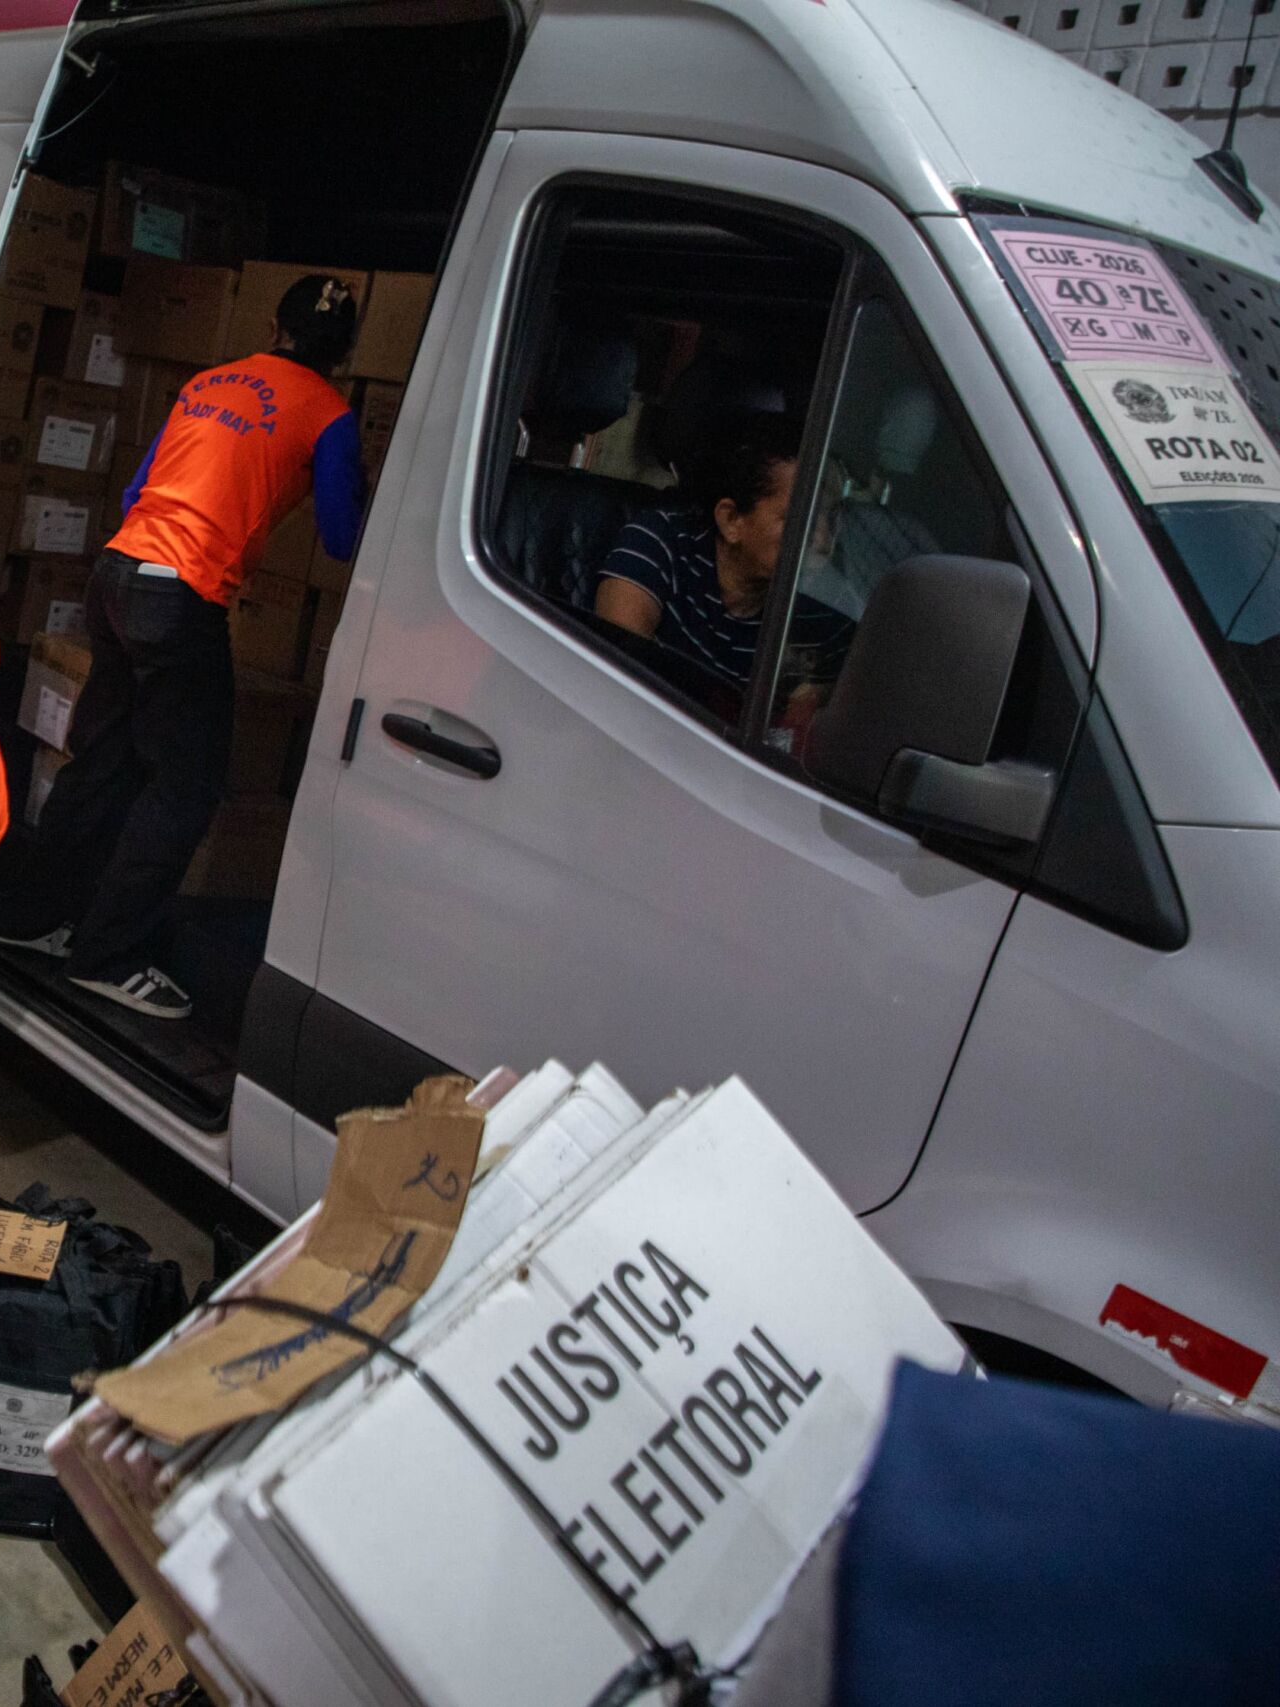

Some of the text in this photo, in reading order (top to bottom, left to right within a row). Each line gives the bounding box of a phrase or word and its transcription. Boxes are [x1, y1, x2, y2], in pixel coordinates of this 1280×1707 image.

[1025, 246, 1083, 267] CLUE
[1093, 252, 1146, 275] 2026
[1087, 319, 1191, 346] G M P
[217, 408, 254, 436] MAY
[1145, 437, 1264, 463] ROTA 02
[34, 1265, 48, 1273] 2
[495, 1239, 710, 1461] JUSTIÇA
[560, 1325, 823, 1602] ELEITORAL
